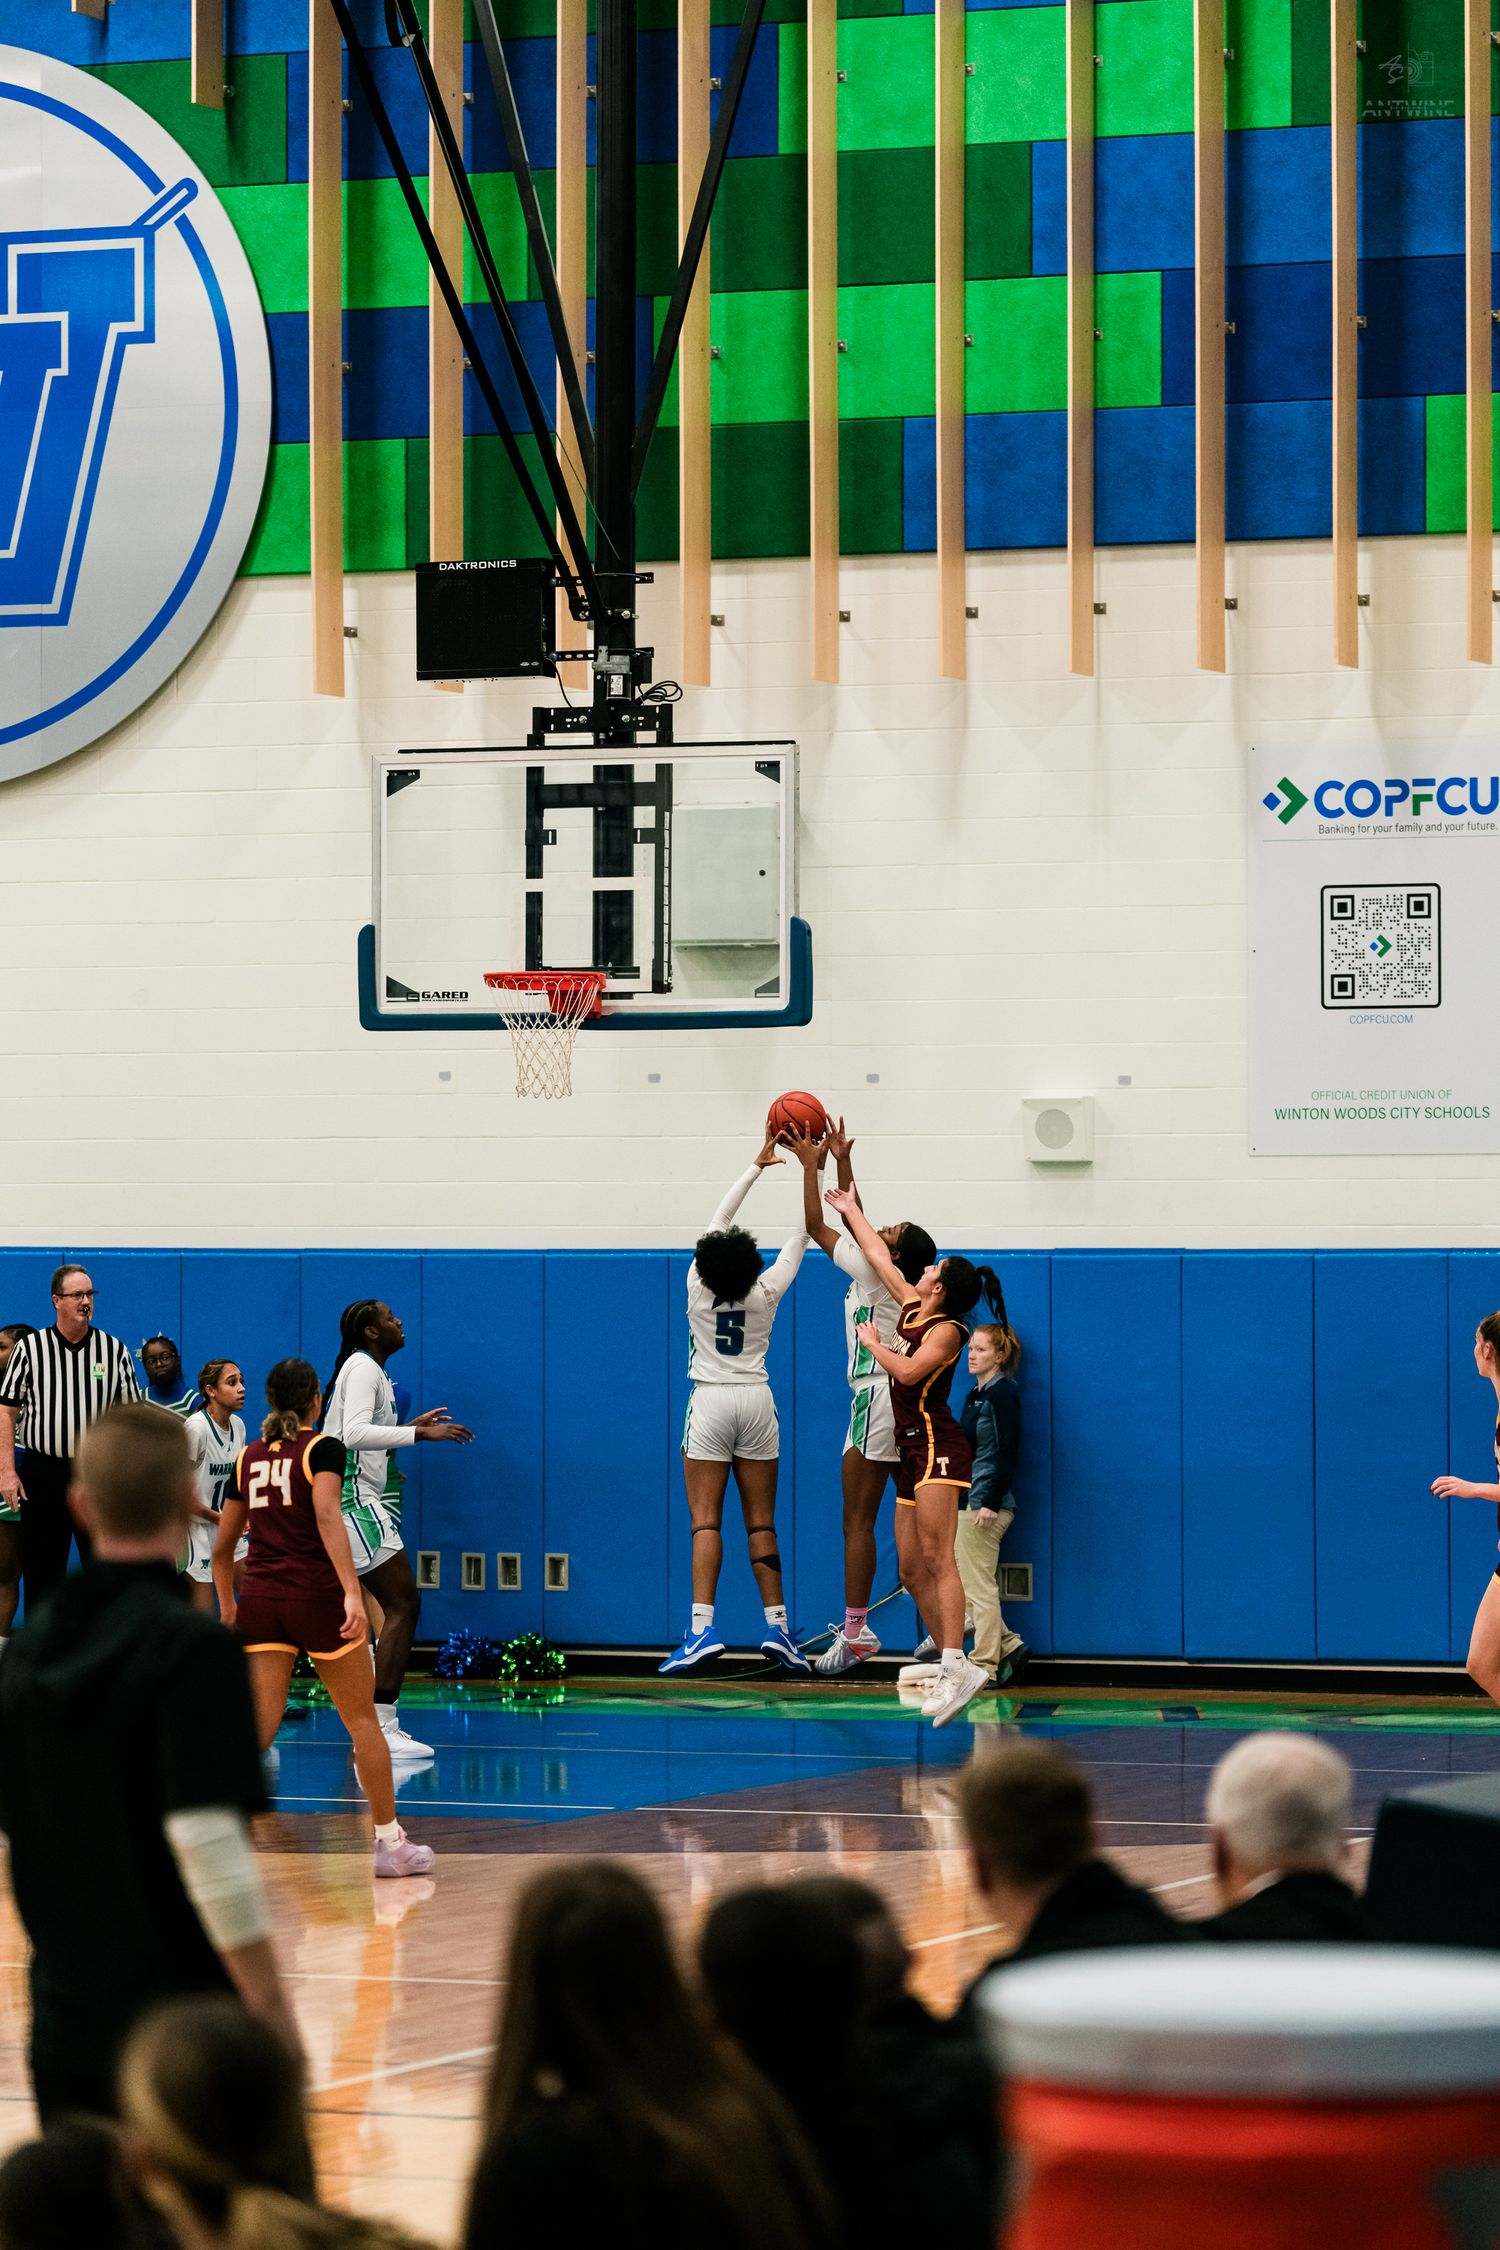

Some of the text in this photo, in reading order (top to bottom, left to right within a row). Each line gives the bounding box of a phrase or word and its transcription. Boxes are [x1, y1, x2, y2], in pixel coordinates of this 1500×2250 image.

[439, 560, 517, 571] DAKTRONICS
[1314, 776, 1500, 819] COPFCU
[1318, 820, 1498, 835] Banking for your family and your future.
[421, 991, 469, 999] GARED
[1350, 1014, 1414, 1024] COPFCU.COM
[1311, 1089, 1452, 1101] OFFICIAL CREDIT UNION OF
[1274, 1106, 1490, 1120] WINTON WOODS CITY SCHOOLS
[715, 1310, 746, 1356] 5
[936, 1456, 950, 1475] T
[248, 1458, 293, 1510] 24
